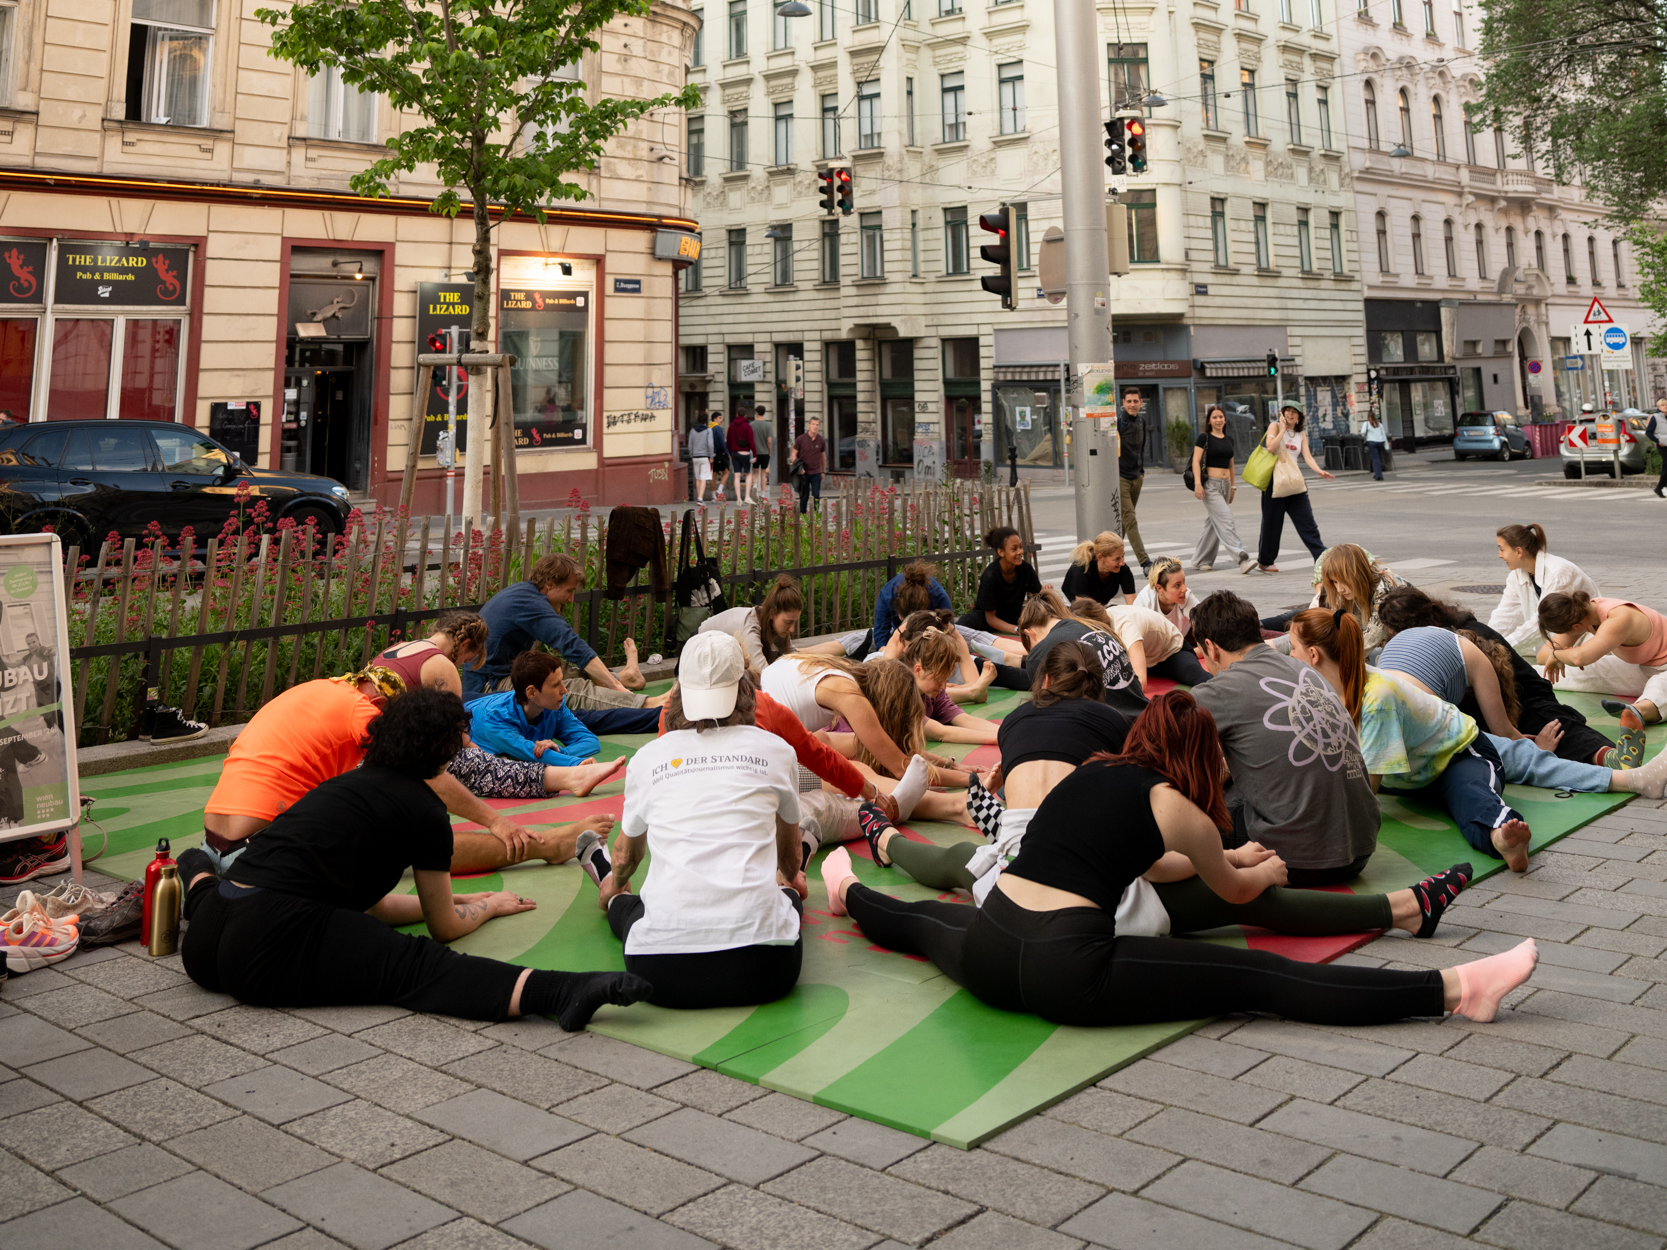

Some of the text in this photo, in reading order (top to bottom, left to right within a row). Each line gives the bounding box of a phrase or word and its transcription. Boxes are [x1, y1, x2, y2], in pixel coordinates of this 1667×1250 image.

[66, 254, 147, 267] THE LIZARD
[76, 271, 135, 281] Pub & Billiards
[438, 292, 461, 302] THE
[509, 292, 526, 300] THE
[429, 304, 470, 315] LIZARD
[503, 300, 532, 309] LIZARD
[425, 414, 436, 422] ub
[514, 429, 523, 437] HE
[514, 437, 530, 446] ARD
[0, 661, 49, 688] BAU
[0, 691, 31, 716] ZT
[0, 730, 43, 746] SEPTEMBER
[652, 754, 769, 777] ICH DER STANDARD
[652, 775, 664, 786] Weil
[665, 764, 735, 779] Qualitätsjournalismus
[736, 764, 759, 774] wichtig
[36, 794, 53, 802] wien
[36, 799, 63, 809] neubau
